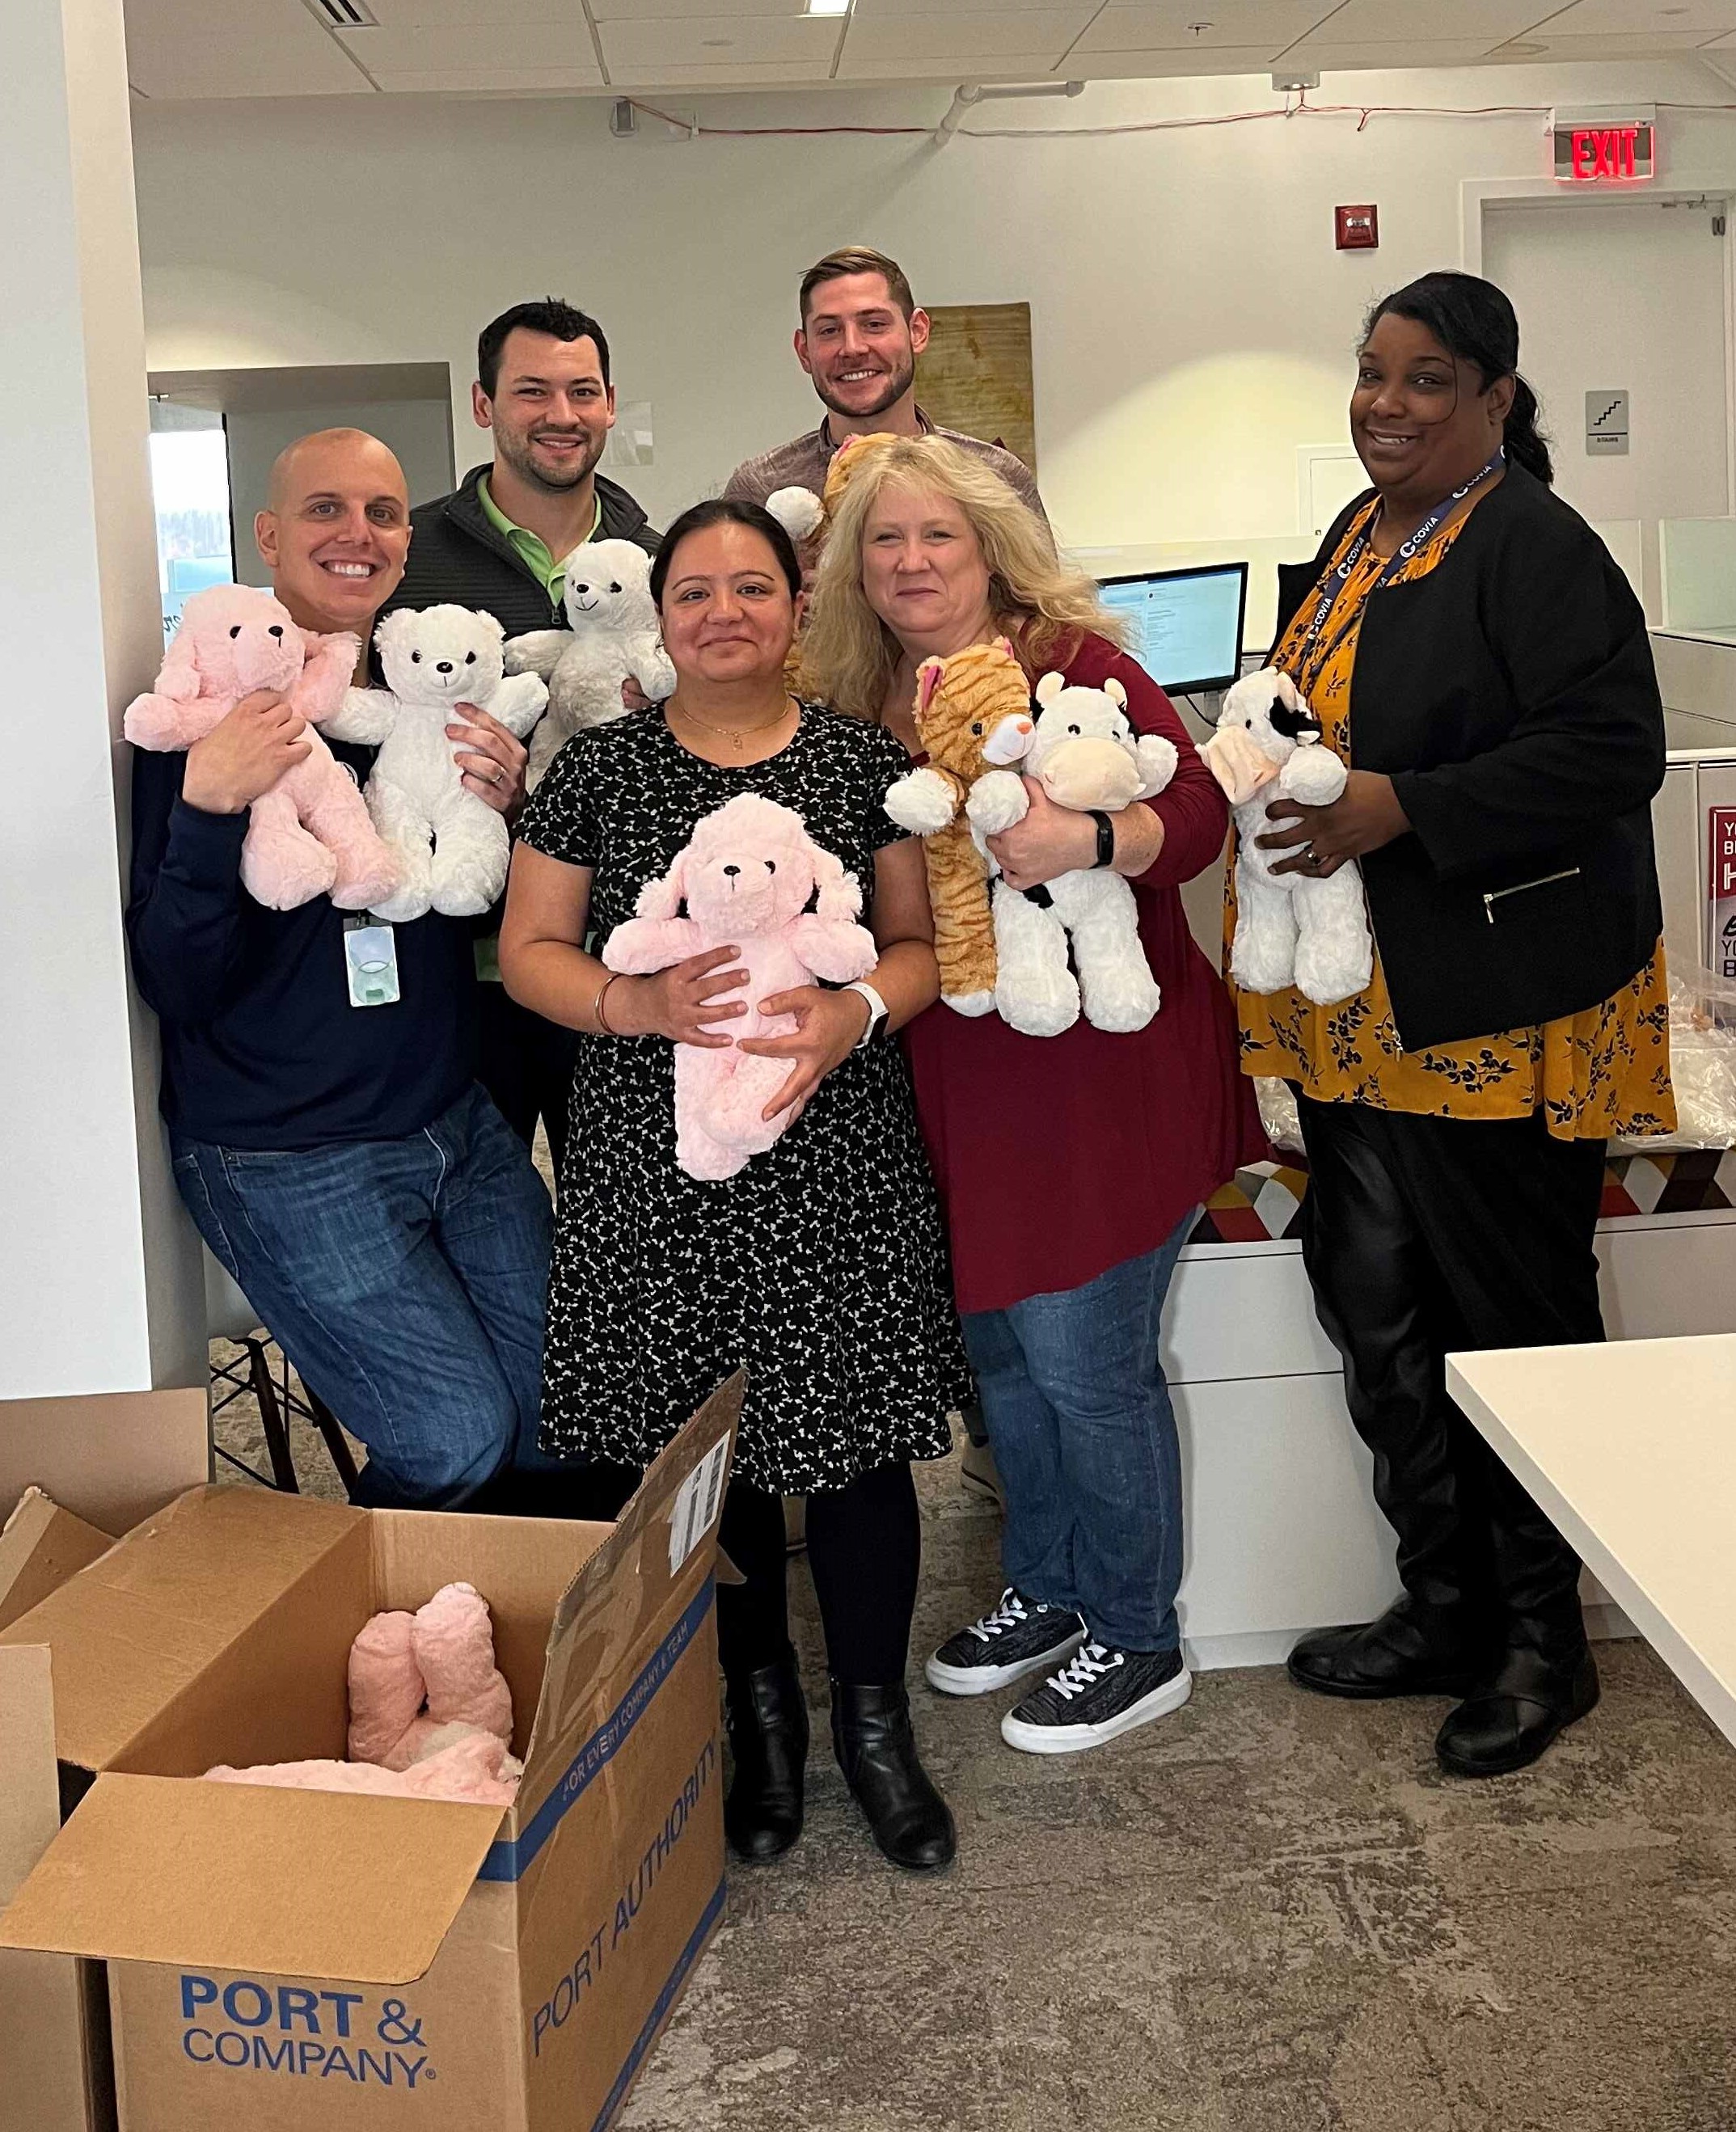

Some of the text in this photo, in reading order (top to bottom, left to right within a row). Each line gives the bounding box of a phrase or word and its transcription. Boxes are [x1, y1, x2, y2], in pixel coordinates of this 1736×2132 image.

[1571, 129, 1637, 178] EXIT
[1346, 537, 1365, 564] COVIA
[1413, 517, 1438, 543] COVIA
[1314, 598, 1333, 625] COVIA
[586, 1719, 620, 1769] EVERY
[620, 1664, 661, 1728] COMPANY
[667, 1620, 688, 1655] TEAM
[532, 1921, 607, 2057] PORT
[611, 1729, 718, 1951] AUTHORITY
[180, 1974, 428, 2047] PORT &
